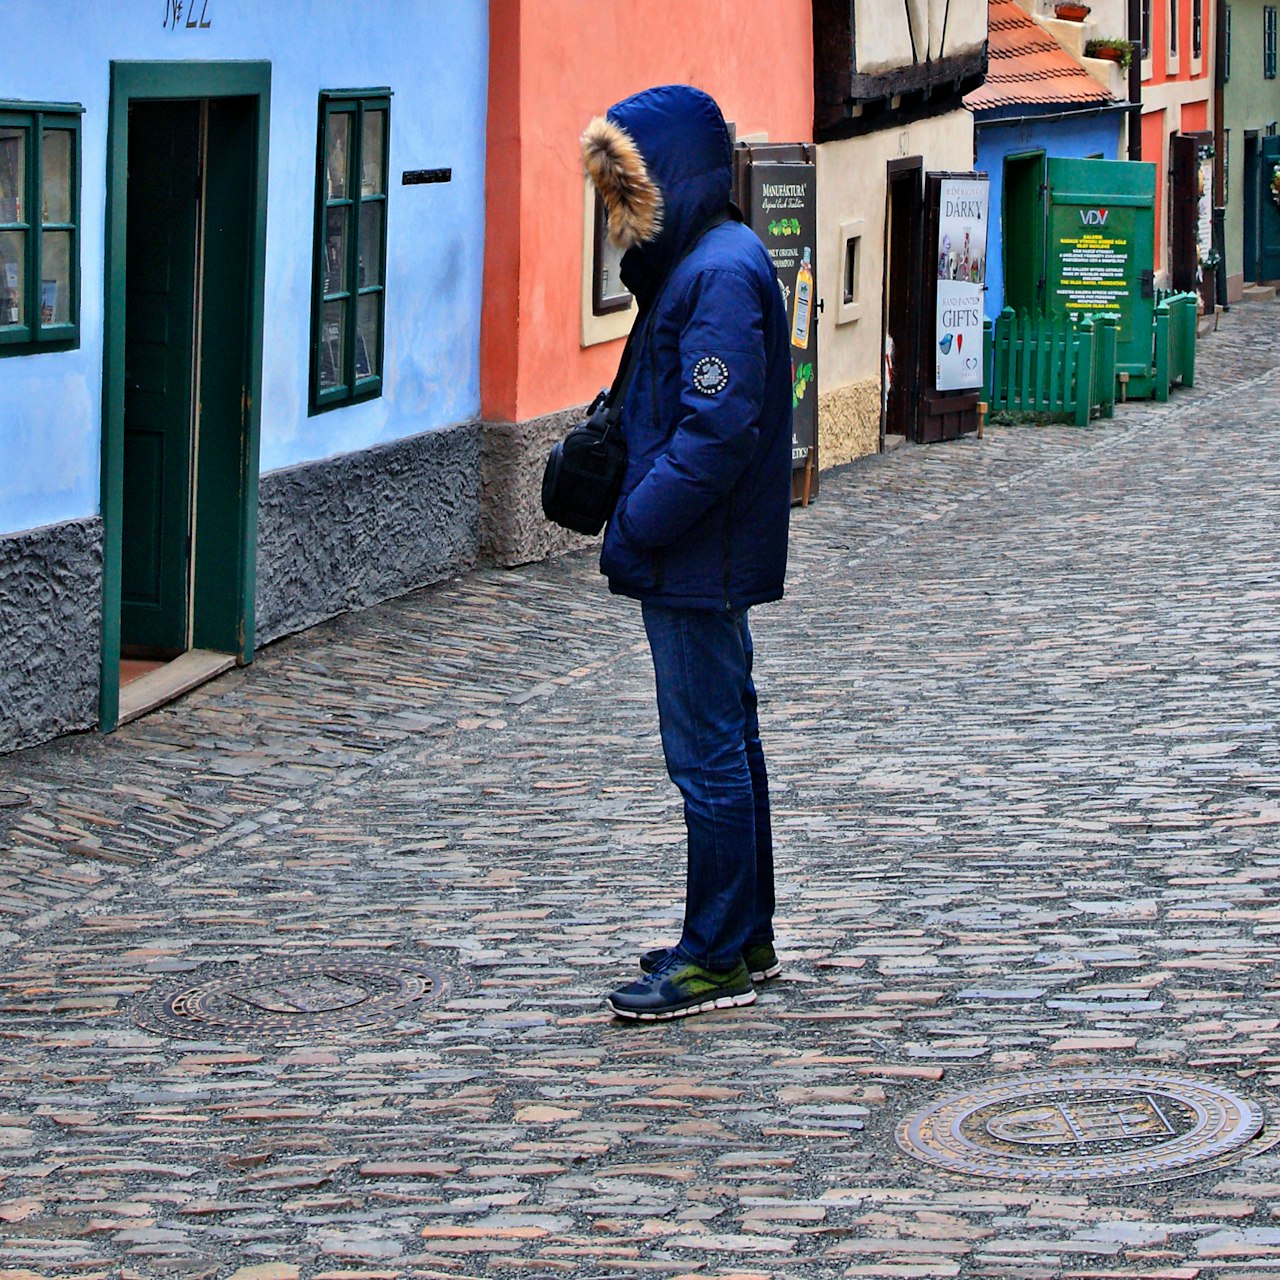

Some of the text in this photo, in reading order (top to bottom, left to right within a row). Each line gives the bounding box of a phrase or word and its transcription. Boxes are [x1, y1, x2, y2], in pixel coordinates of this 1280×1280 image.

[945, 196, 983, 218] DÁRKY
[1080, 209, 1108, 225] VDV
[942, 308, 979, 328] GIFTS
